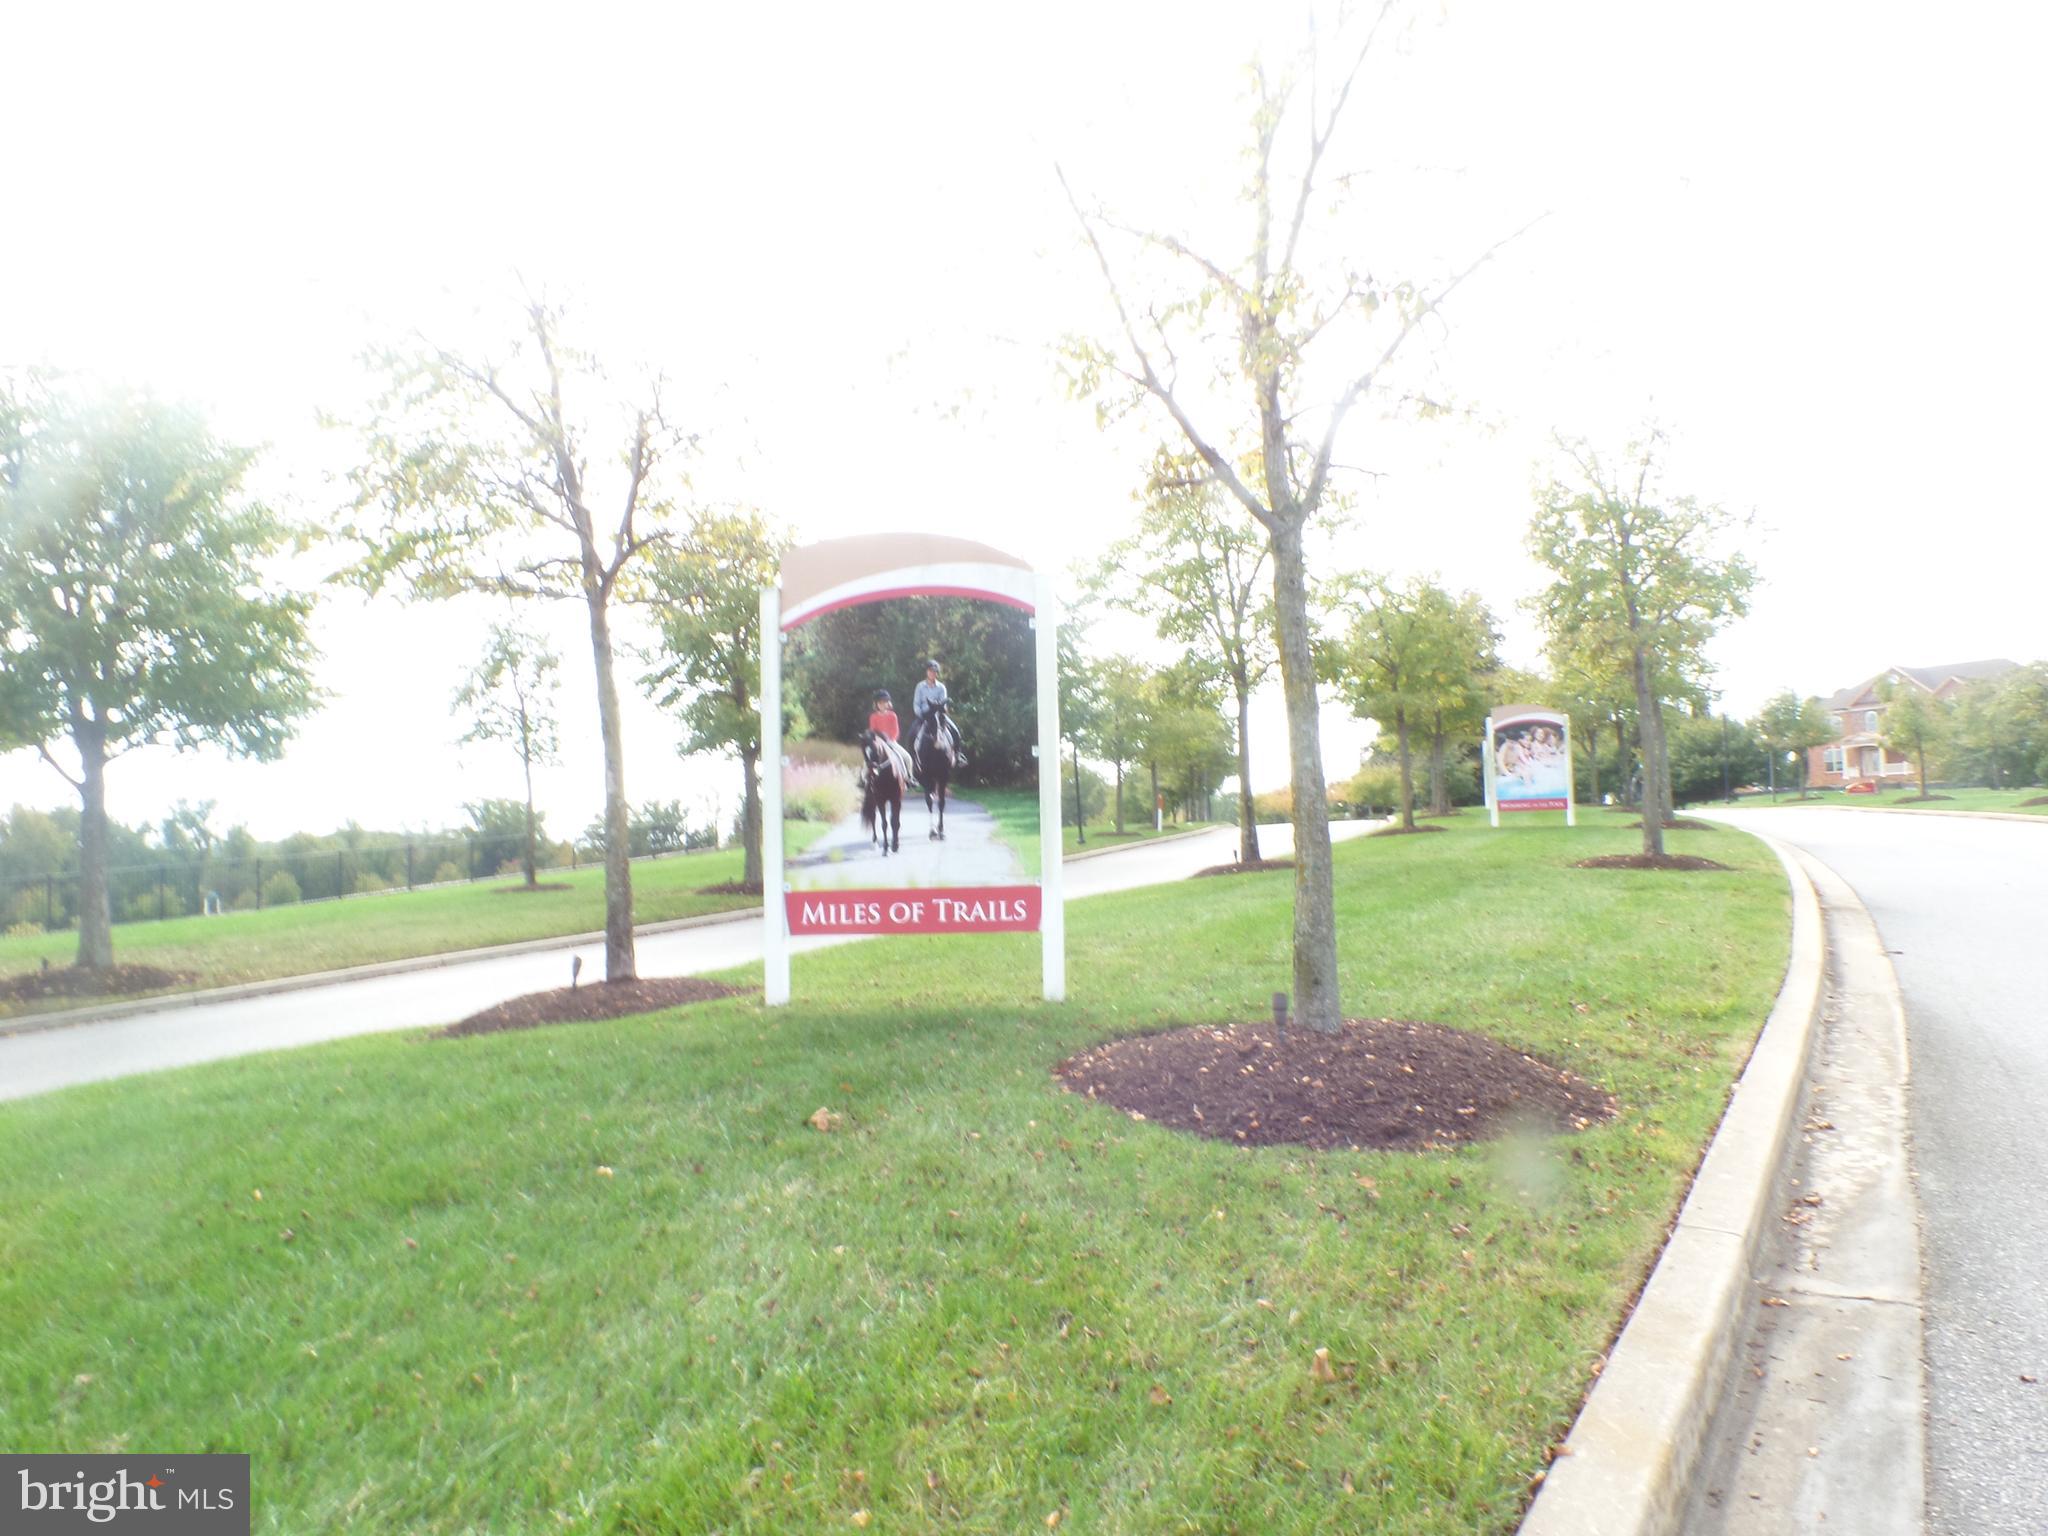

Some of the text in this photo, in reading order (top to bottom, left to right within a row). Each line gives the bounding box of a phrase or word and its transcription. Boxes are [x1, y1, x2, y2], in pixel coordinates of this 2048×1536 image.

[801, 898, 1028, 926] MILES OF TRAILS
